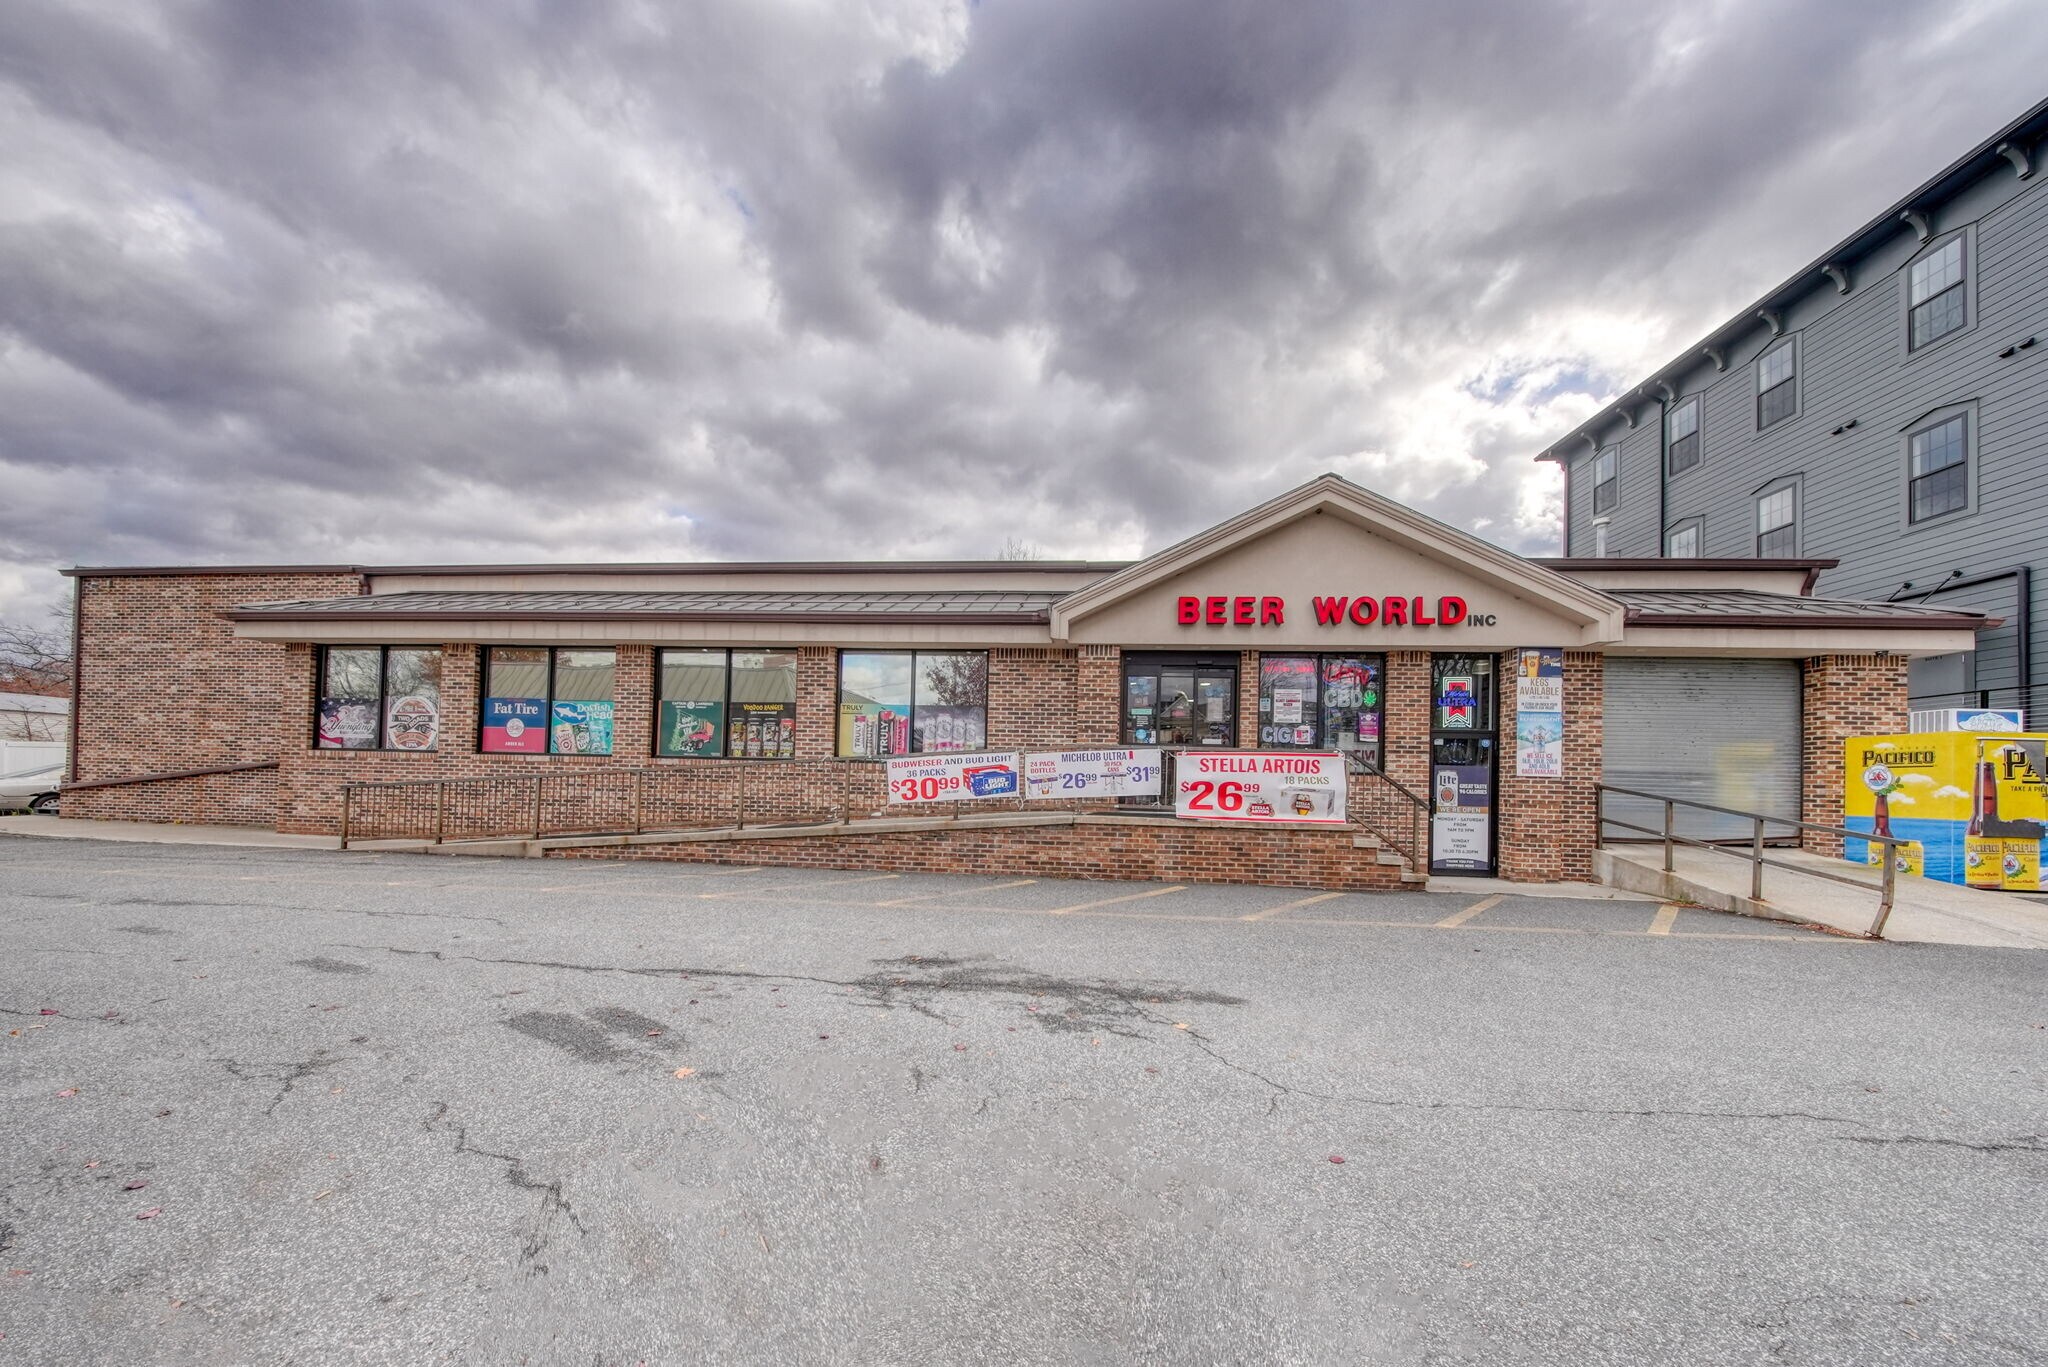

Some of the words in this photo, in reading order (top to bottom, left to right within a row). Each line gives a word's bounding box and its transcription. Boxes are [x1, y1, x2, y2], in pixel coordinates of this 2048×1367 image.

[1178, 596, 1285, 625] BEER
[1312, 596, 1468, 625] WORLD
[1467, 614, 1497, 627] INC
[1530, 678, 1549, 686] KEGS
[1520, 687, 1560, 696] AVAILABLE
[1324, 689, 1363, 708] CBD
[1438, 697, 1477, 706] ULTRA
[494, 702, 513, 714] Fat
[514, 703, 539, 714] Tire
[587, 711, 613, 720] Head
[880, 721, 889, 753] TRULY
[892, 759, 942, 768] BUDWEISER
[944, 757, 963, 765] AND
[986, 755, 1012, 763] LIGHT
[1061, 752, 1101, 763] MICHELOB
[1103, 751, 1127, 760] ULTRA
[1862, 750, 1936, 767] PACIFICO
[1199, 757, 1257, 773] STELLA
[1262, 759, 1321, 774] ARTOIS
[906, 769, 918, 777] 36
[919, 768, 946, 777] PACKS
[985, 781, 1010, 790] LIGHT
[1284, 776, 1295, 785] 18
[1297, 776, 1330, 785] PACKS
[1439, 775, 1457, 786] Lite
